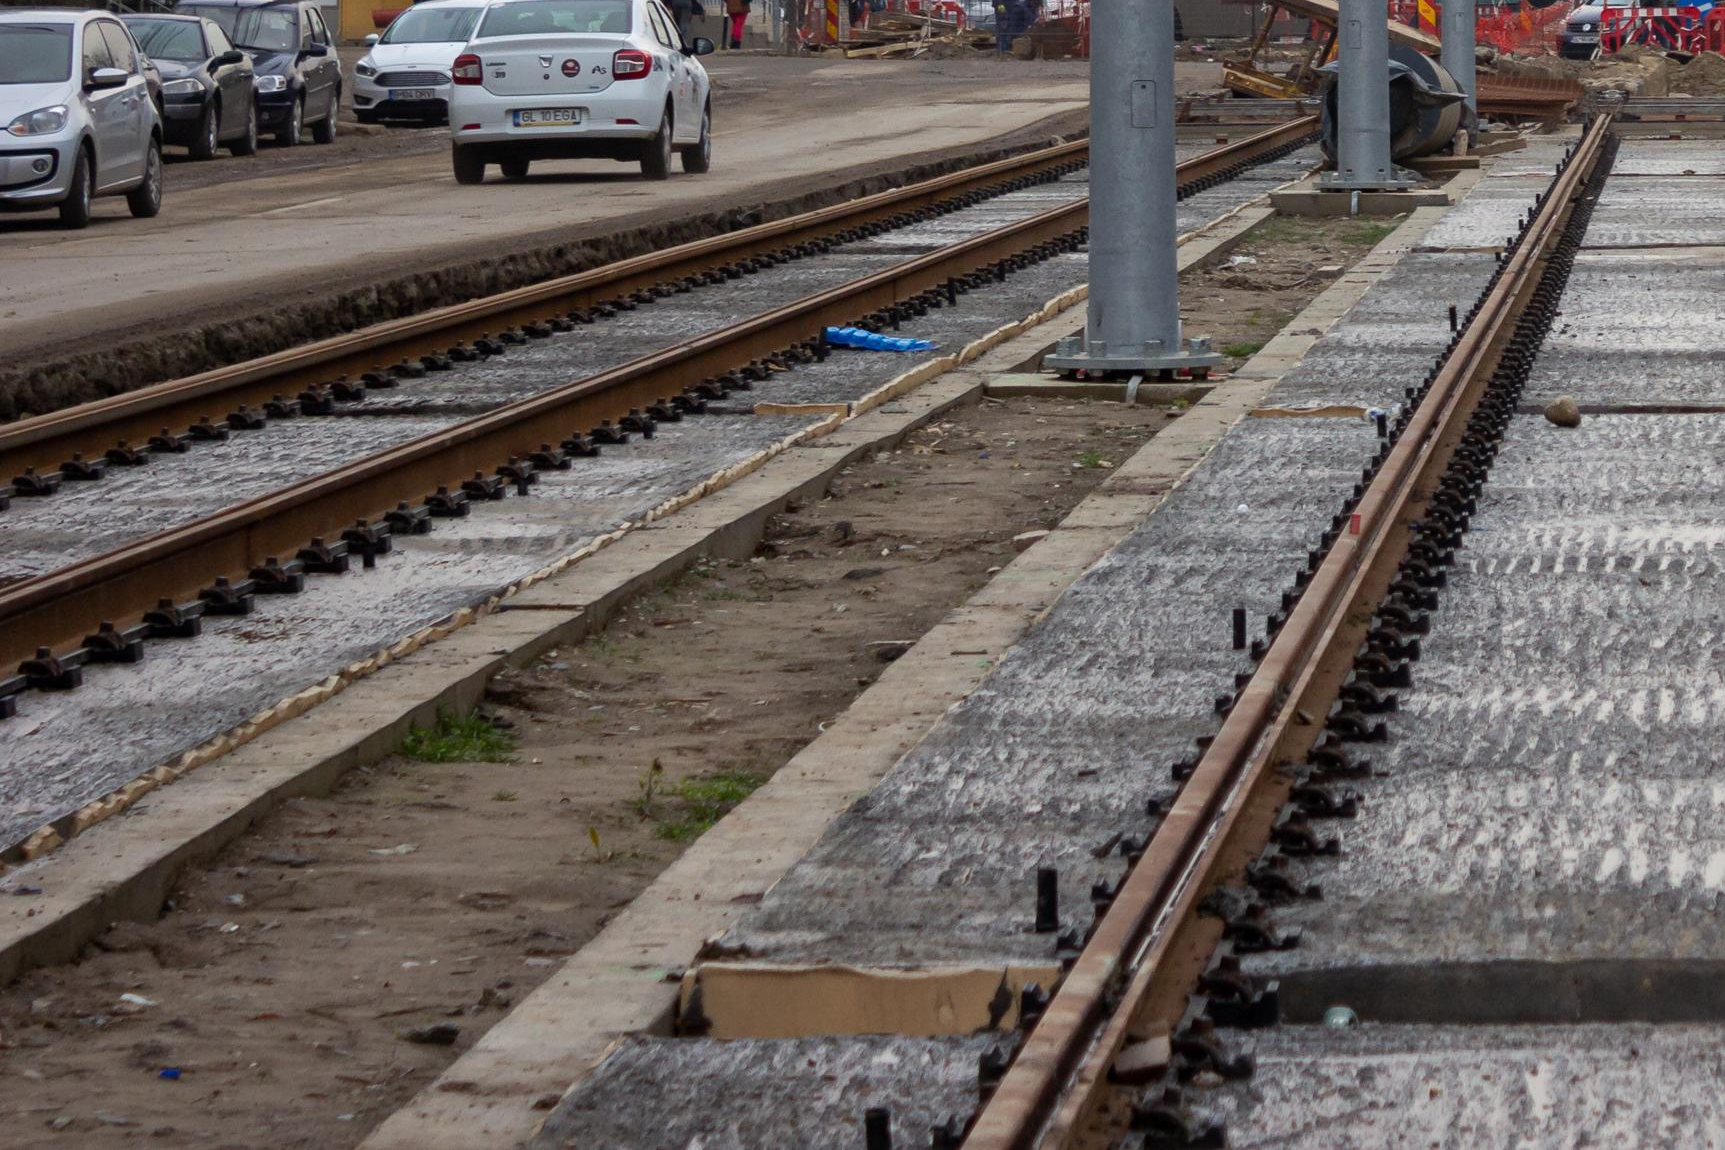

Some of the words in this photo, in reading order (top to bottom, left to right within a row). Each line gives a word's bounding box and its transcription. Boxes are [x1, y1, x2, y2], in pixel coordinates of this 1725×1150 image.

[522, 112, 536, 122] GL
[541, 110, 552, 122] 10
[553, 110, 577, 121] EGA
